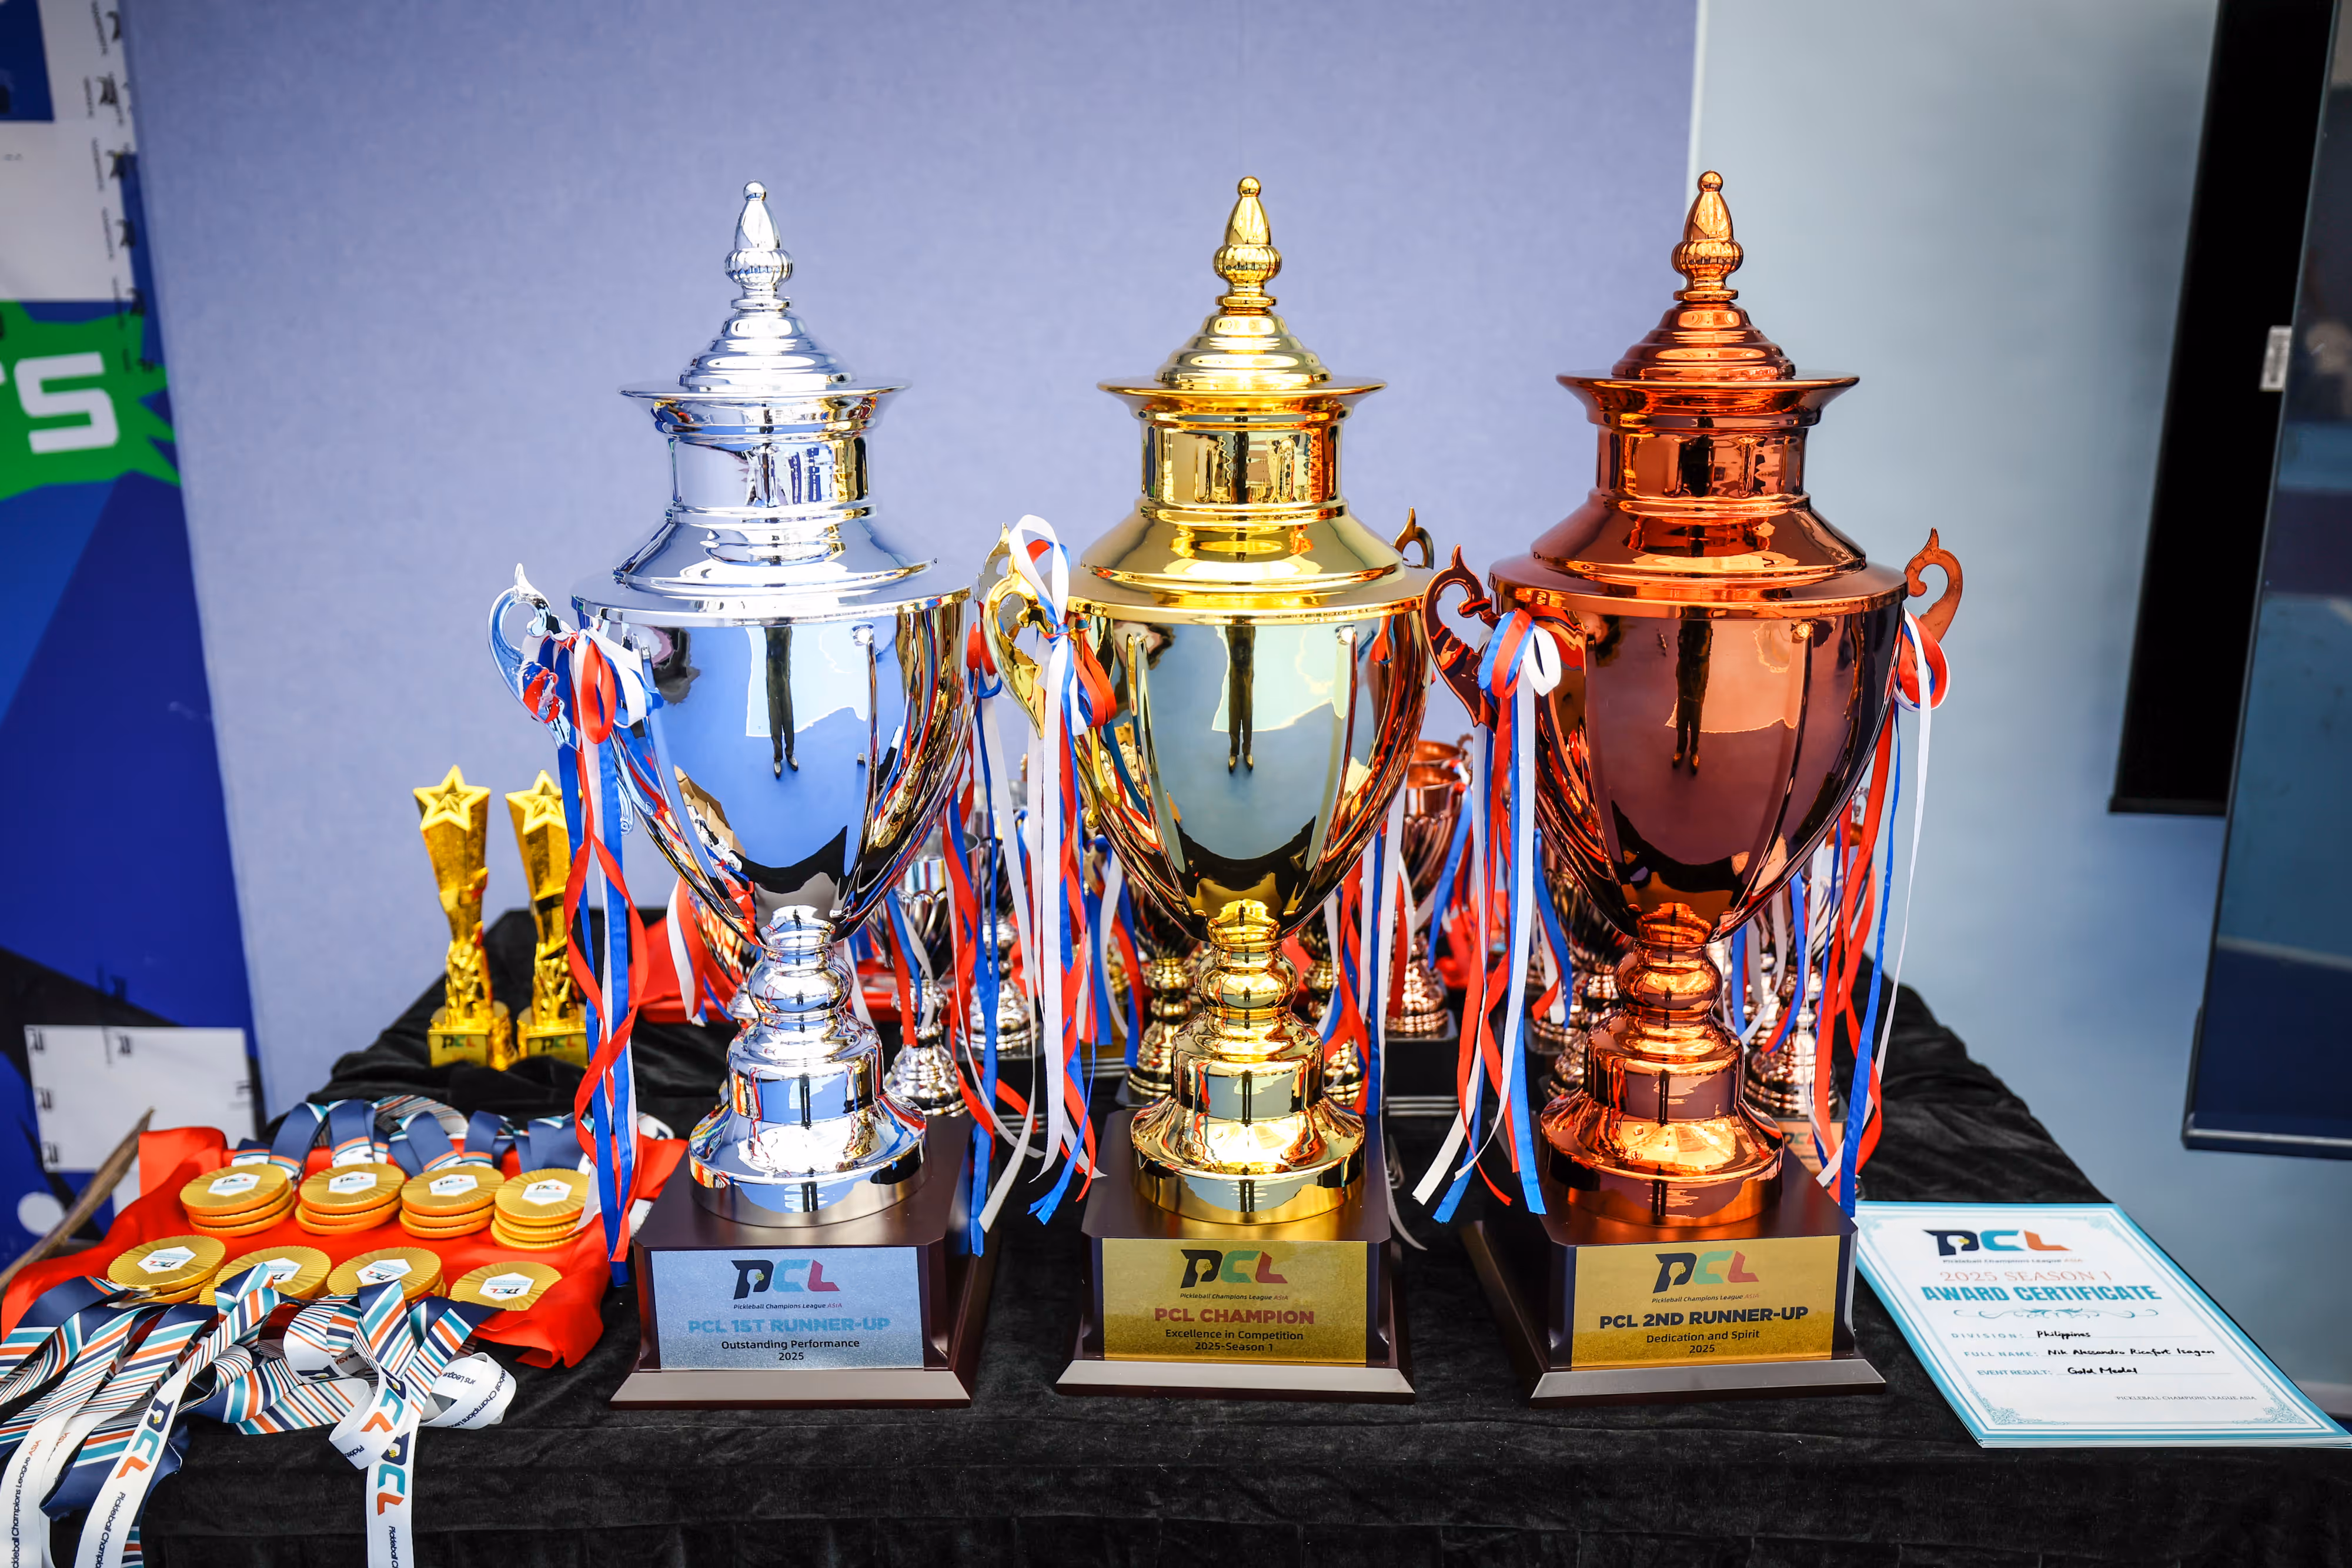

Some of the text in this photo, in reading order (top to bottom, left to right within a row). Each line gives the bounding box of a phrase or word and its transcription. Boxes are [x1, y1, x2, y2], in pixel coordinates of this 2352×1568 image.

[0, 351, 119, 454] S
[1922, 1229, 2072, 1256] PCL
[731, 1259, 840, 1299] PCL
[1180, 1249, 1288, 1289] PCL
[1653, 1251, 1759, 1293] PCL
[1940, 1271, 1997, 1281] 2025
[2004, 1271, 2096, 1281] SEASON
[1921, 1285, 2163, 1301] AWARD CERTIFICATE
[688, 1317, 891, 1333] PCL 1ST RUNNER-UP
[1154, 1308, 1314, 1324] PCL CHAMPION
[1600, 1306, 1808, 1329] PCL 2ND RUNNER-UP
[721, 1338, 860, 1352] Outstanding Performance
[1166, 1329, 1304, 1342] Excellence in Competition
[1195, 1342, 1273, 1352] 2025-Season 1
[1646, 1329, 1760, 1343] Dedication and Spirit
[2036, 1330, 2091, 1339] Philippines
[779, 1351, 804, 1361] 2025
[1689, 1344, 1715, 1353] 2025
[360, 1368, 406, 1432] PCL
[462, 1390, 497, 1423] Champions
[116, 1398, 175, 1479] PCL
[377, 1432, 410, 1516] PCL
[11, 1485, 21, 1536] Champions
[16, 1456, 31, 1488] League
[29, 1440, 42, 1456] ASIA
[105, 1492, 126, 1532] Pickleball
[389, 1526, 398, 1560] Pickleball
